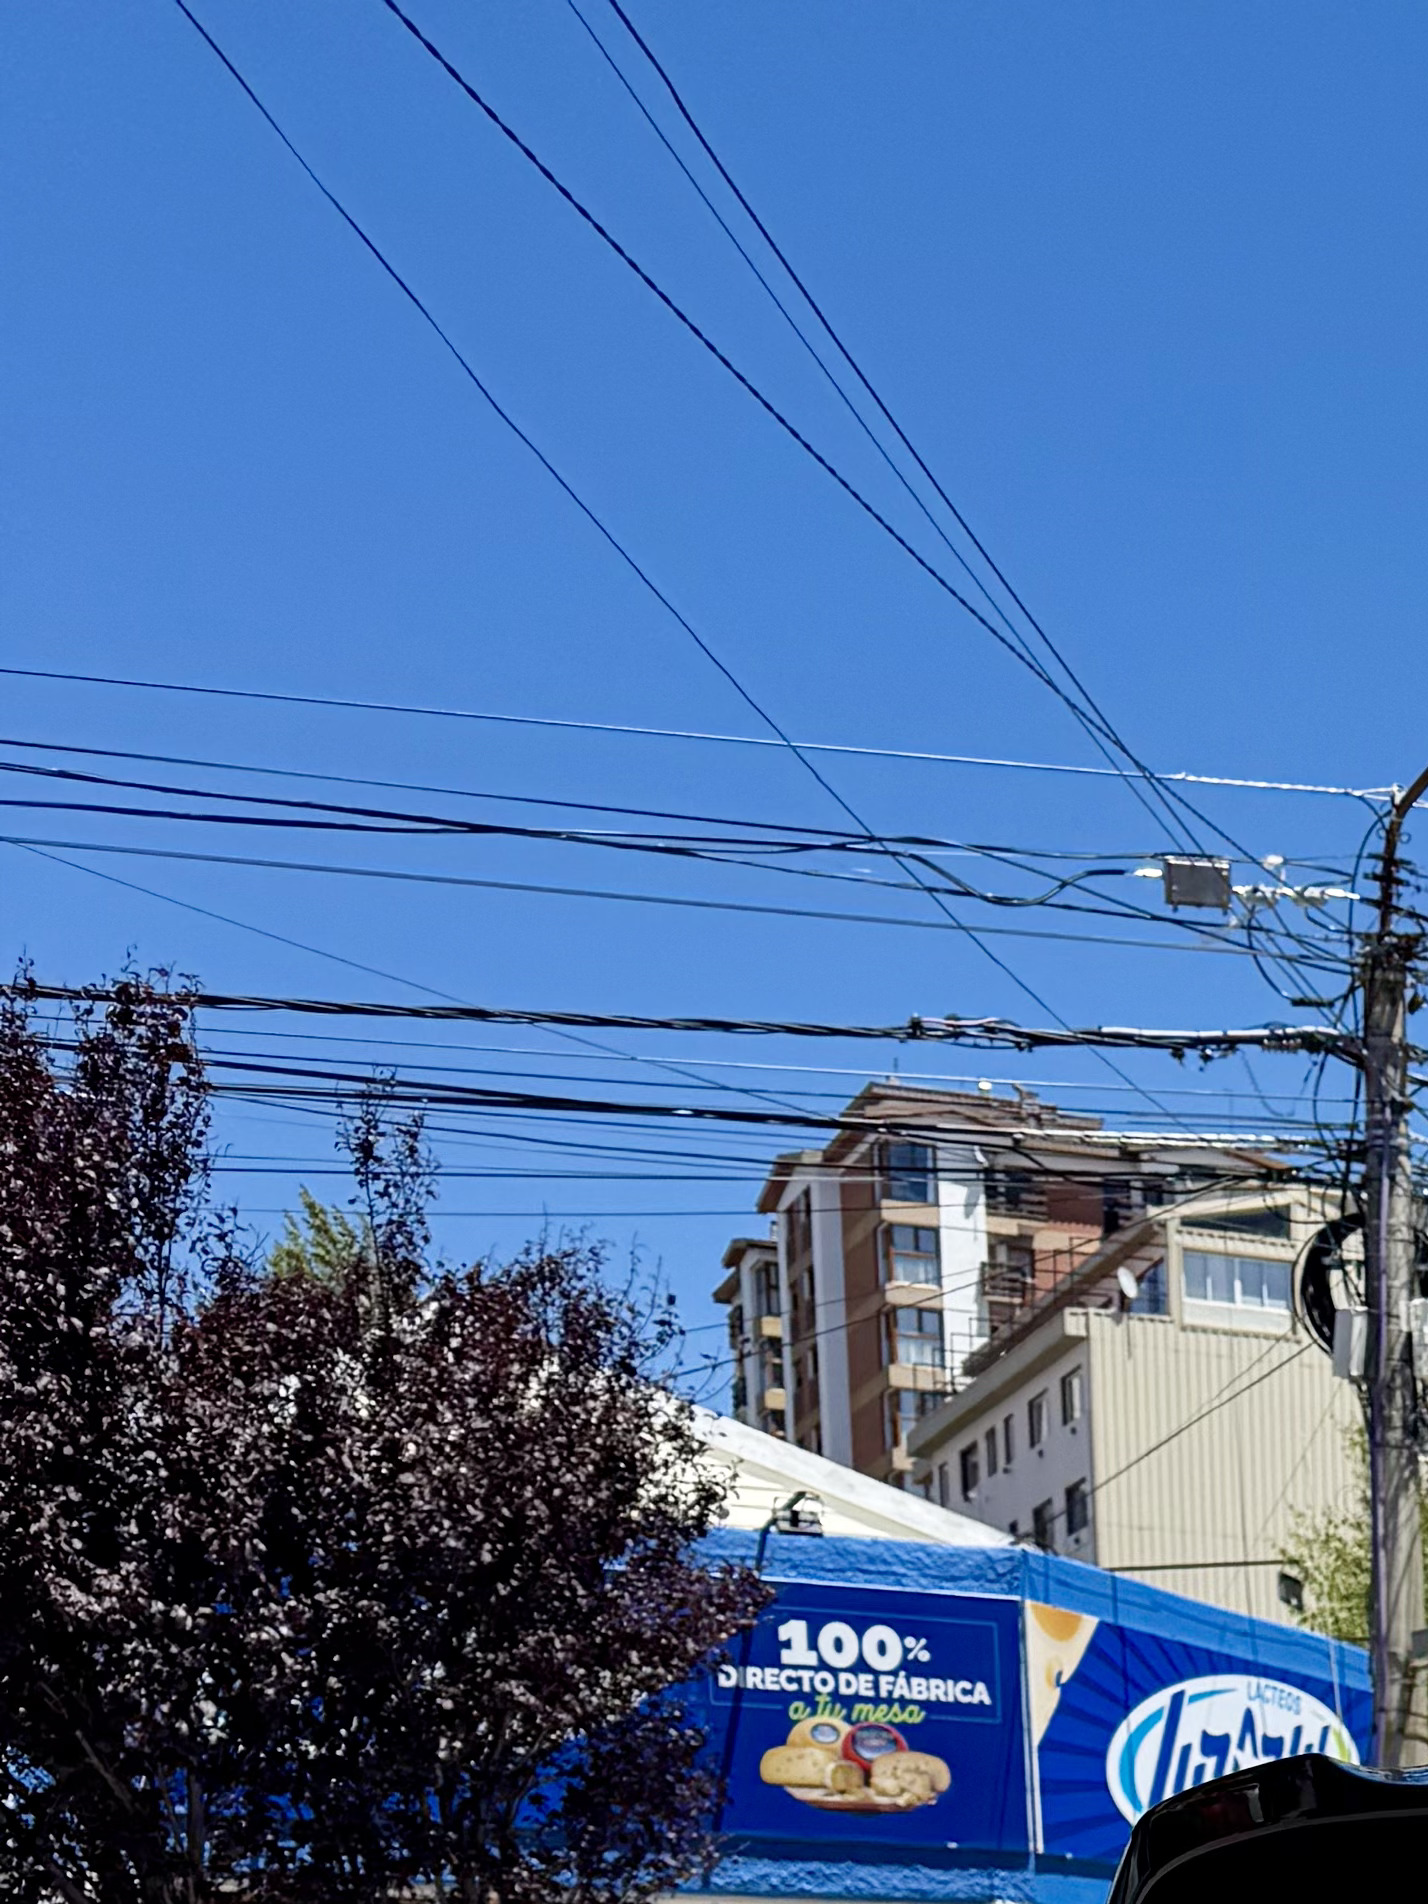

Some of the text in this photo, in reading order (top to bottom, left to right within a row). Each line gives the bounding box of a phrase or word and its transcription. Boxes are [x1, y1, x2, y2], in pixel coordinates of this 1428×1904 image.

[778, 1619, 931, 1671] 100%
[717, 1665, 992, 1705] DIRECTO DE FÁBRICA
[788, 1703, 810, 1721] a
[851, 1703, 927, 1724] mesa
